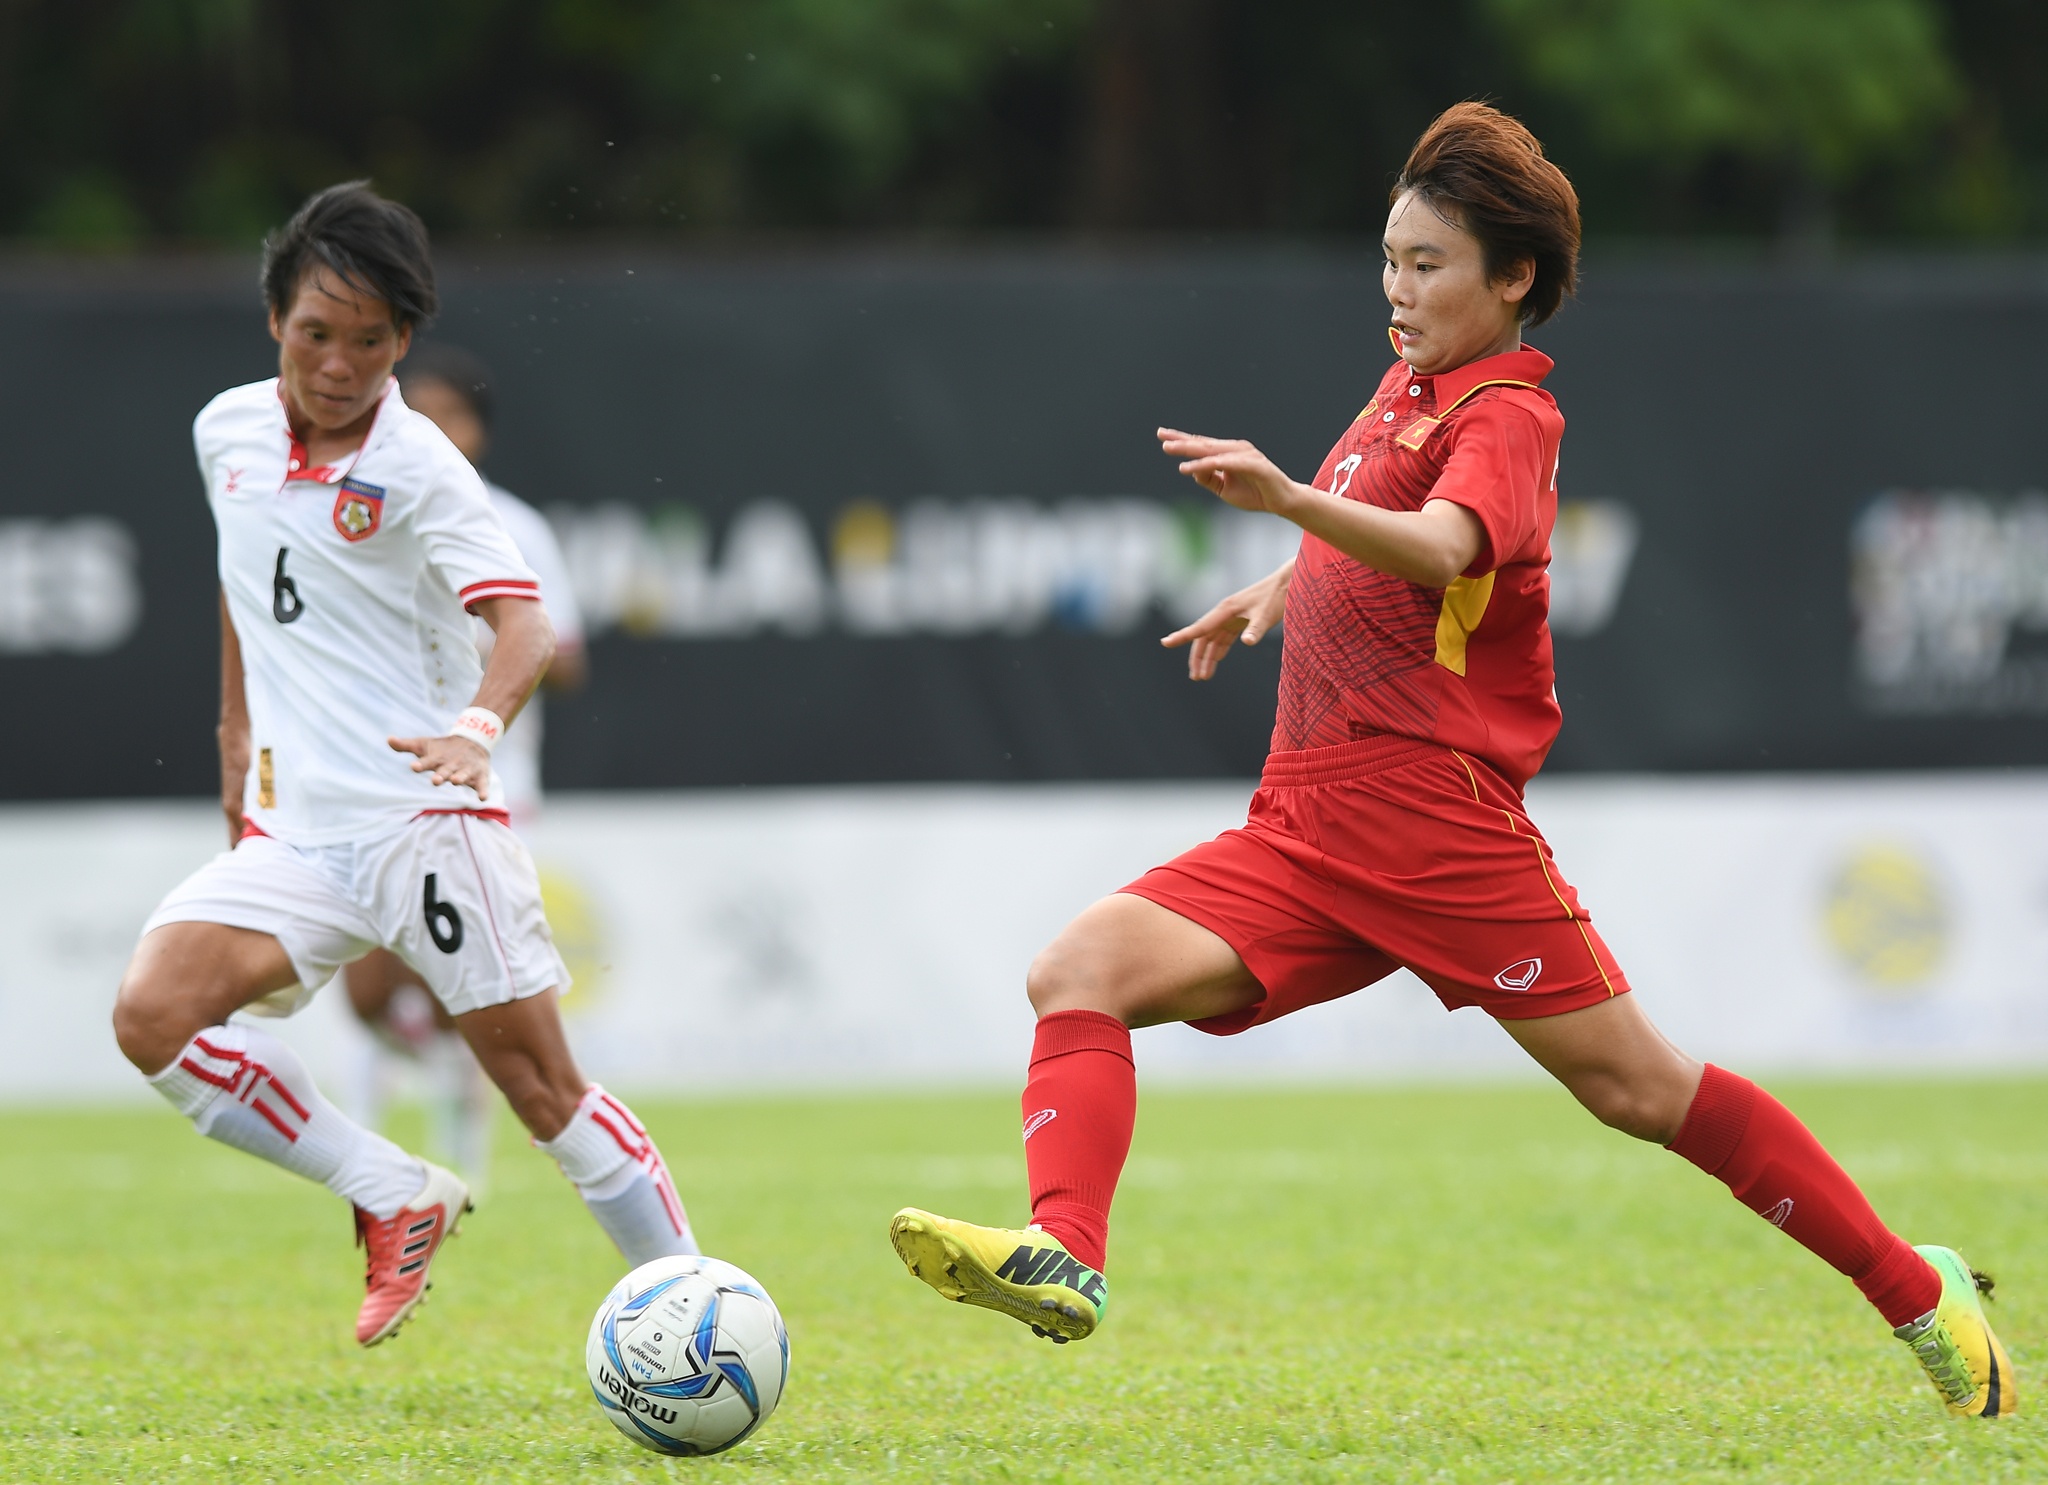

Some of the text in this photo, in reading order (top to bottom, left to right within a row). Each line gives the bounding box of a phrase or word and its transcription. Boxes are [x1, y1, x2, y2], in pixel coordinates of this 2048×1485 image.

[273, 546, 305, 624] 6
[424, 872, 464, 954] 6
[995, 1245, 1107, 1308] NIKE
[599, 1364, 678, 1424] molten
